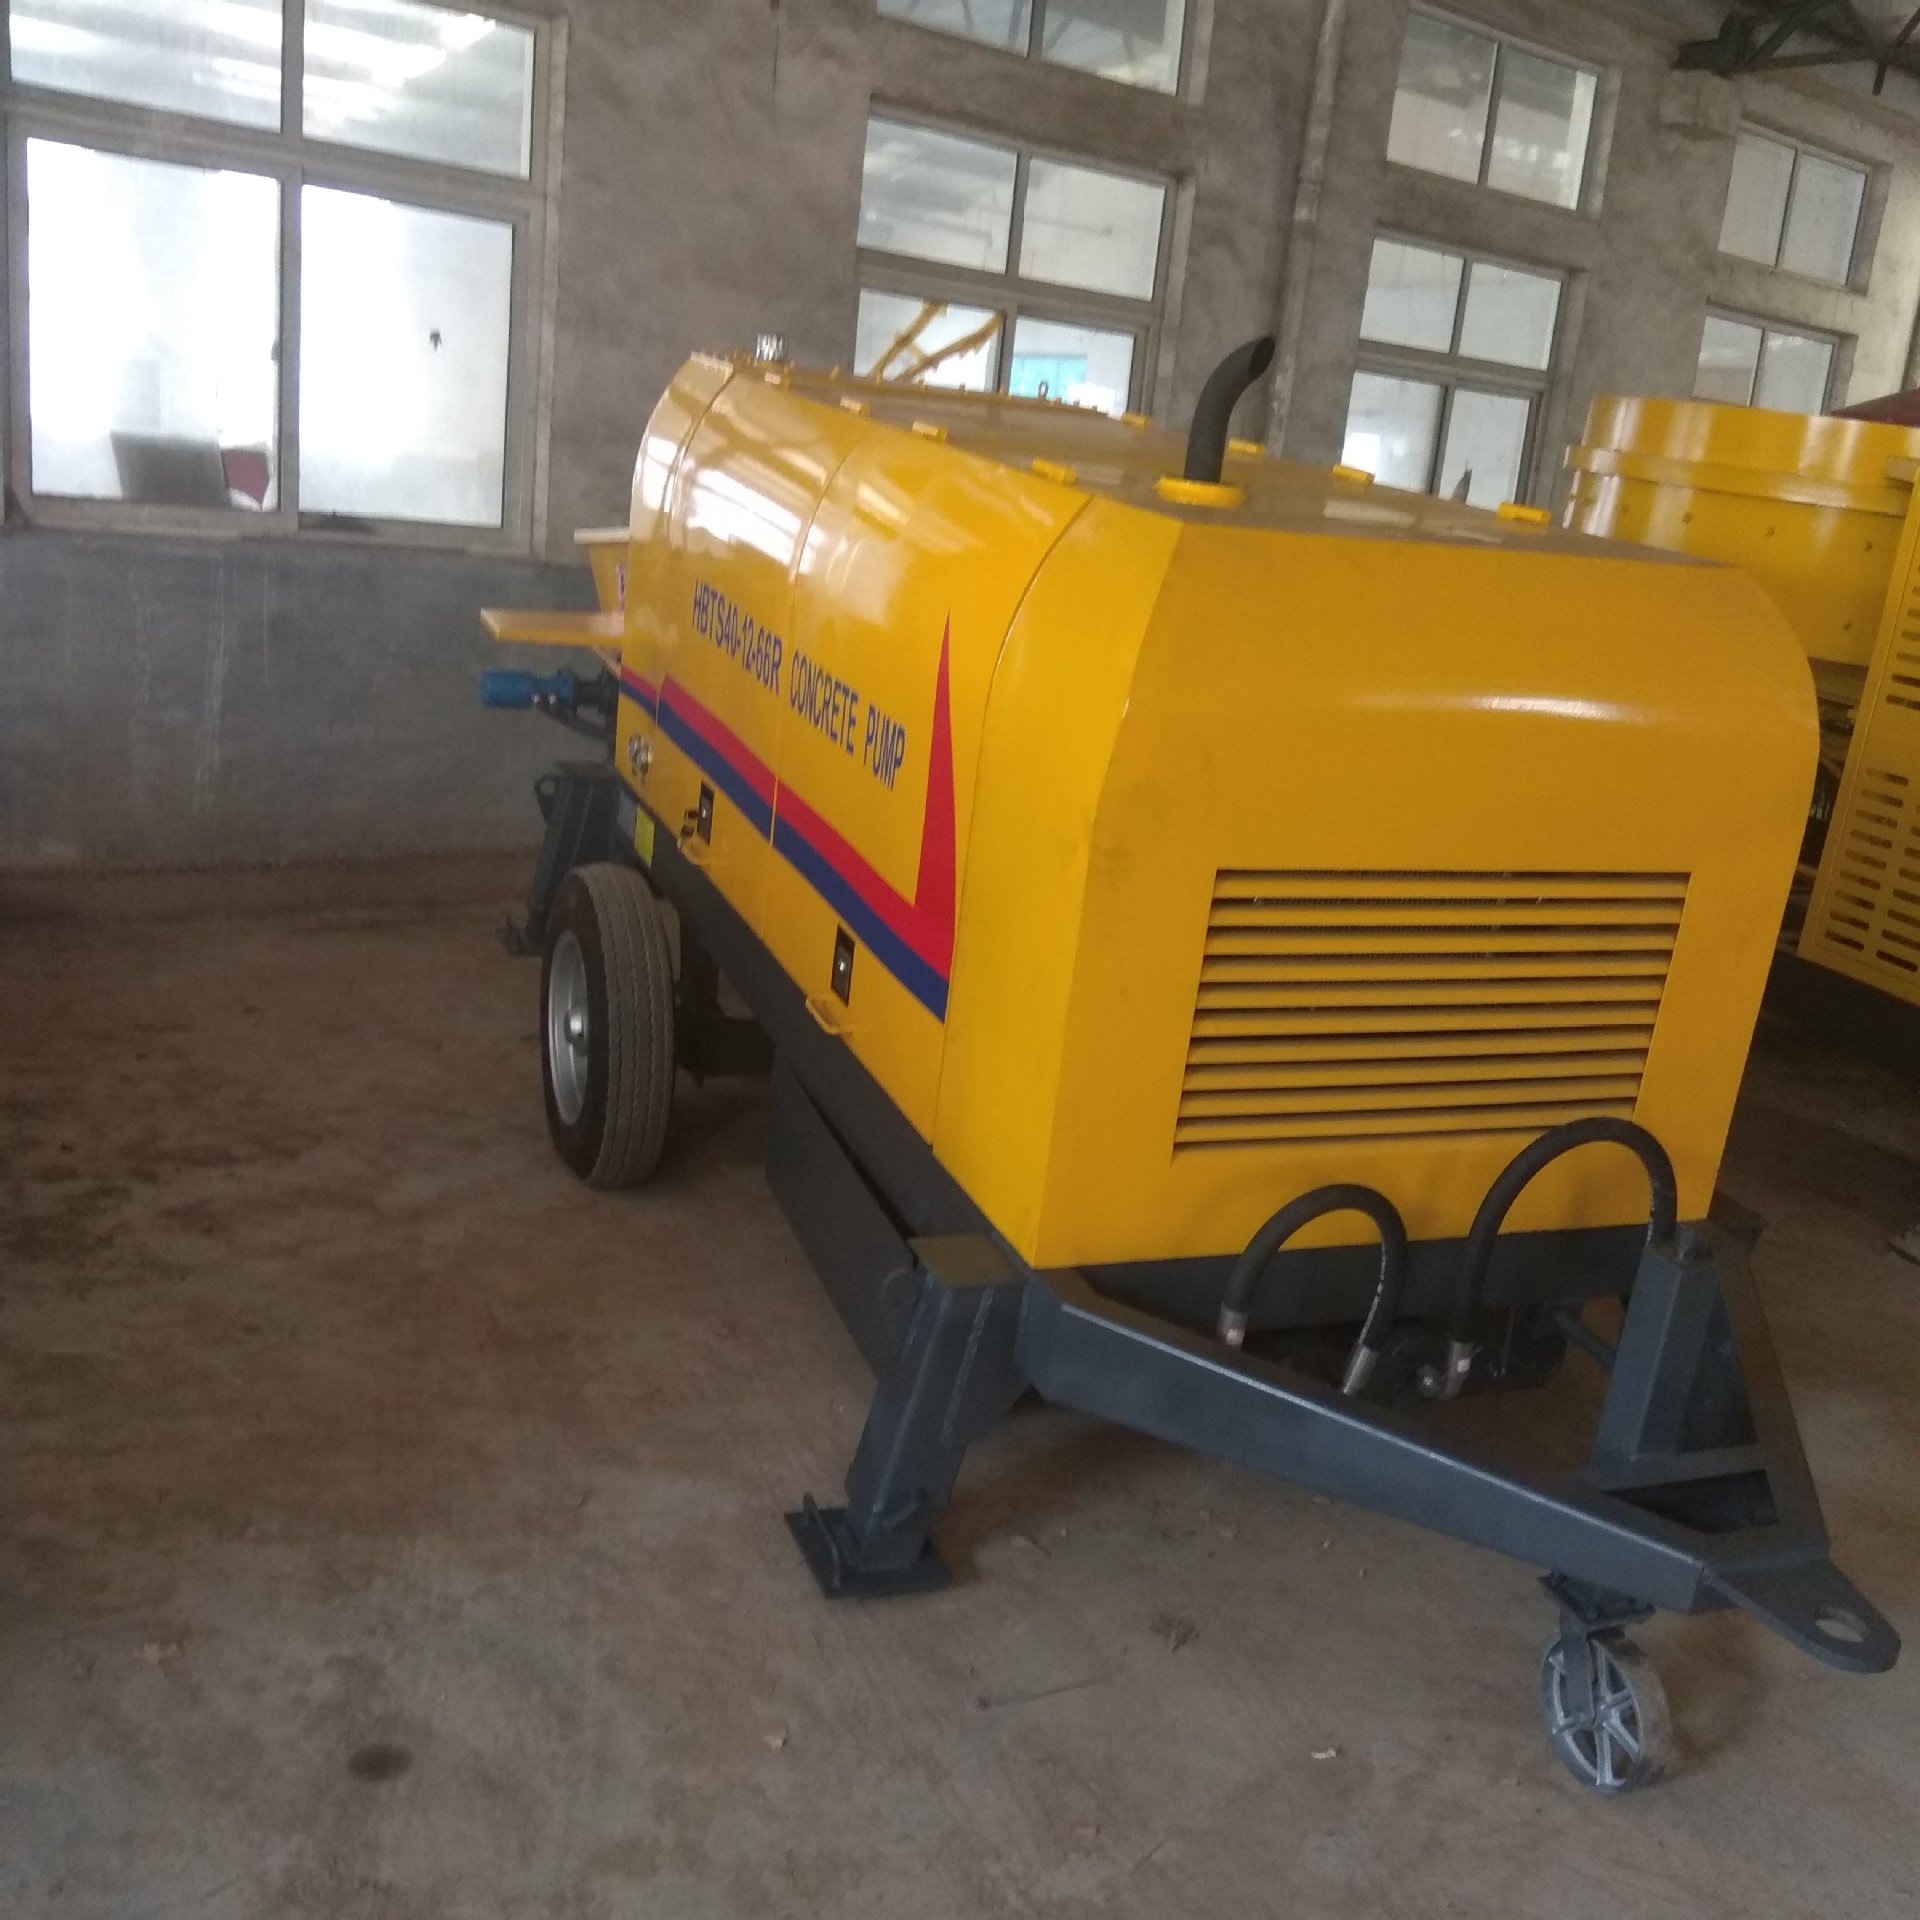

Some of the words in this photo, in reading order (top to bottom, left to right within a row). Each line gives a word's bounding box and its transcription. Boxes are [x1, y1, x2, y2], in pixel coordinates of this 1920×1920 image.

[692, 577, 783, 695] HBTS40-12-66R
[790, 649, 858, 756] CONCRETE
[863, 703, 905, 791] PUMP
